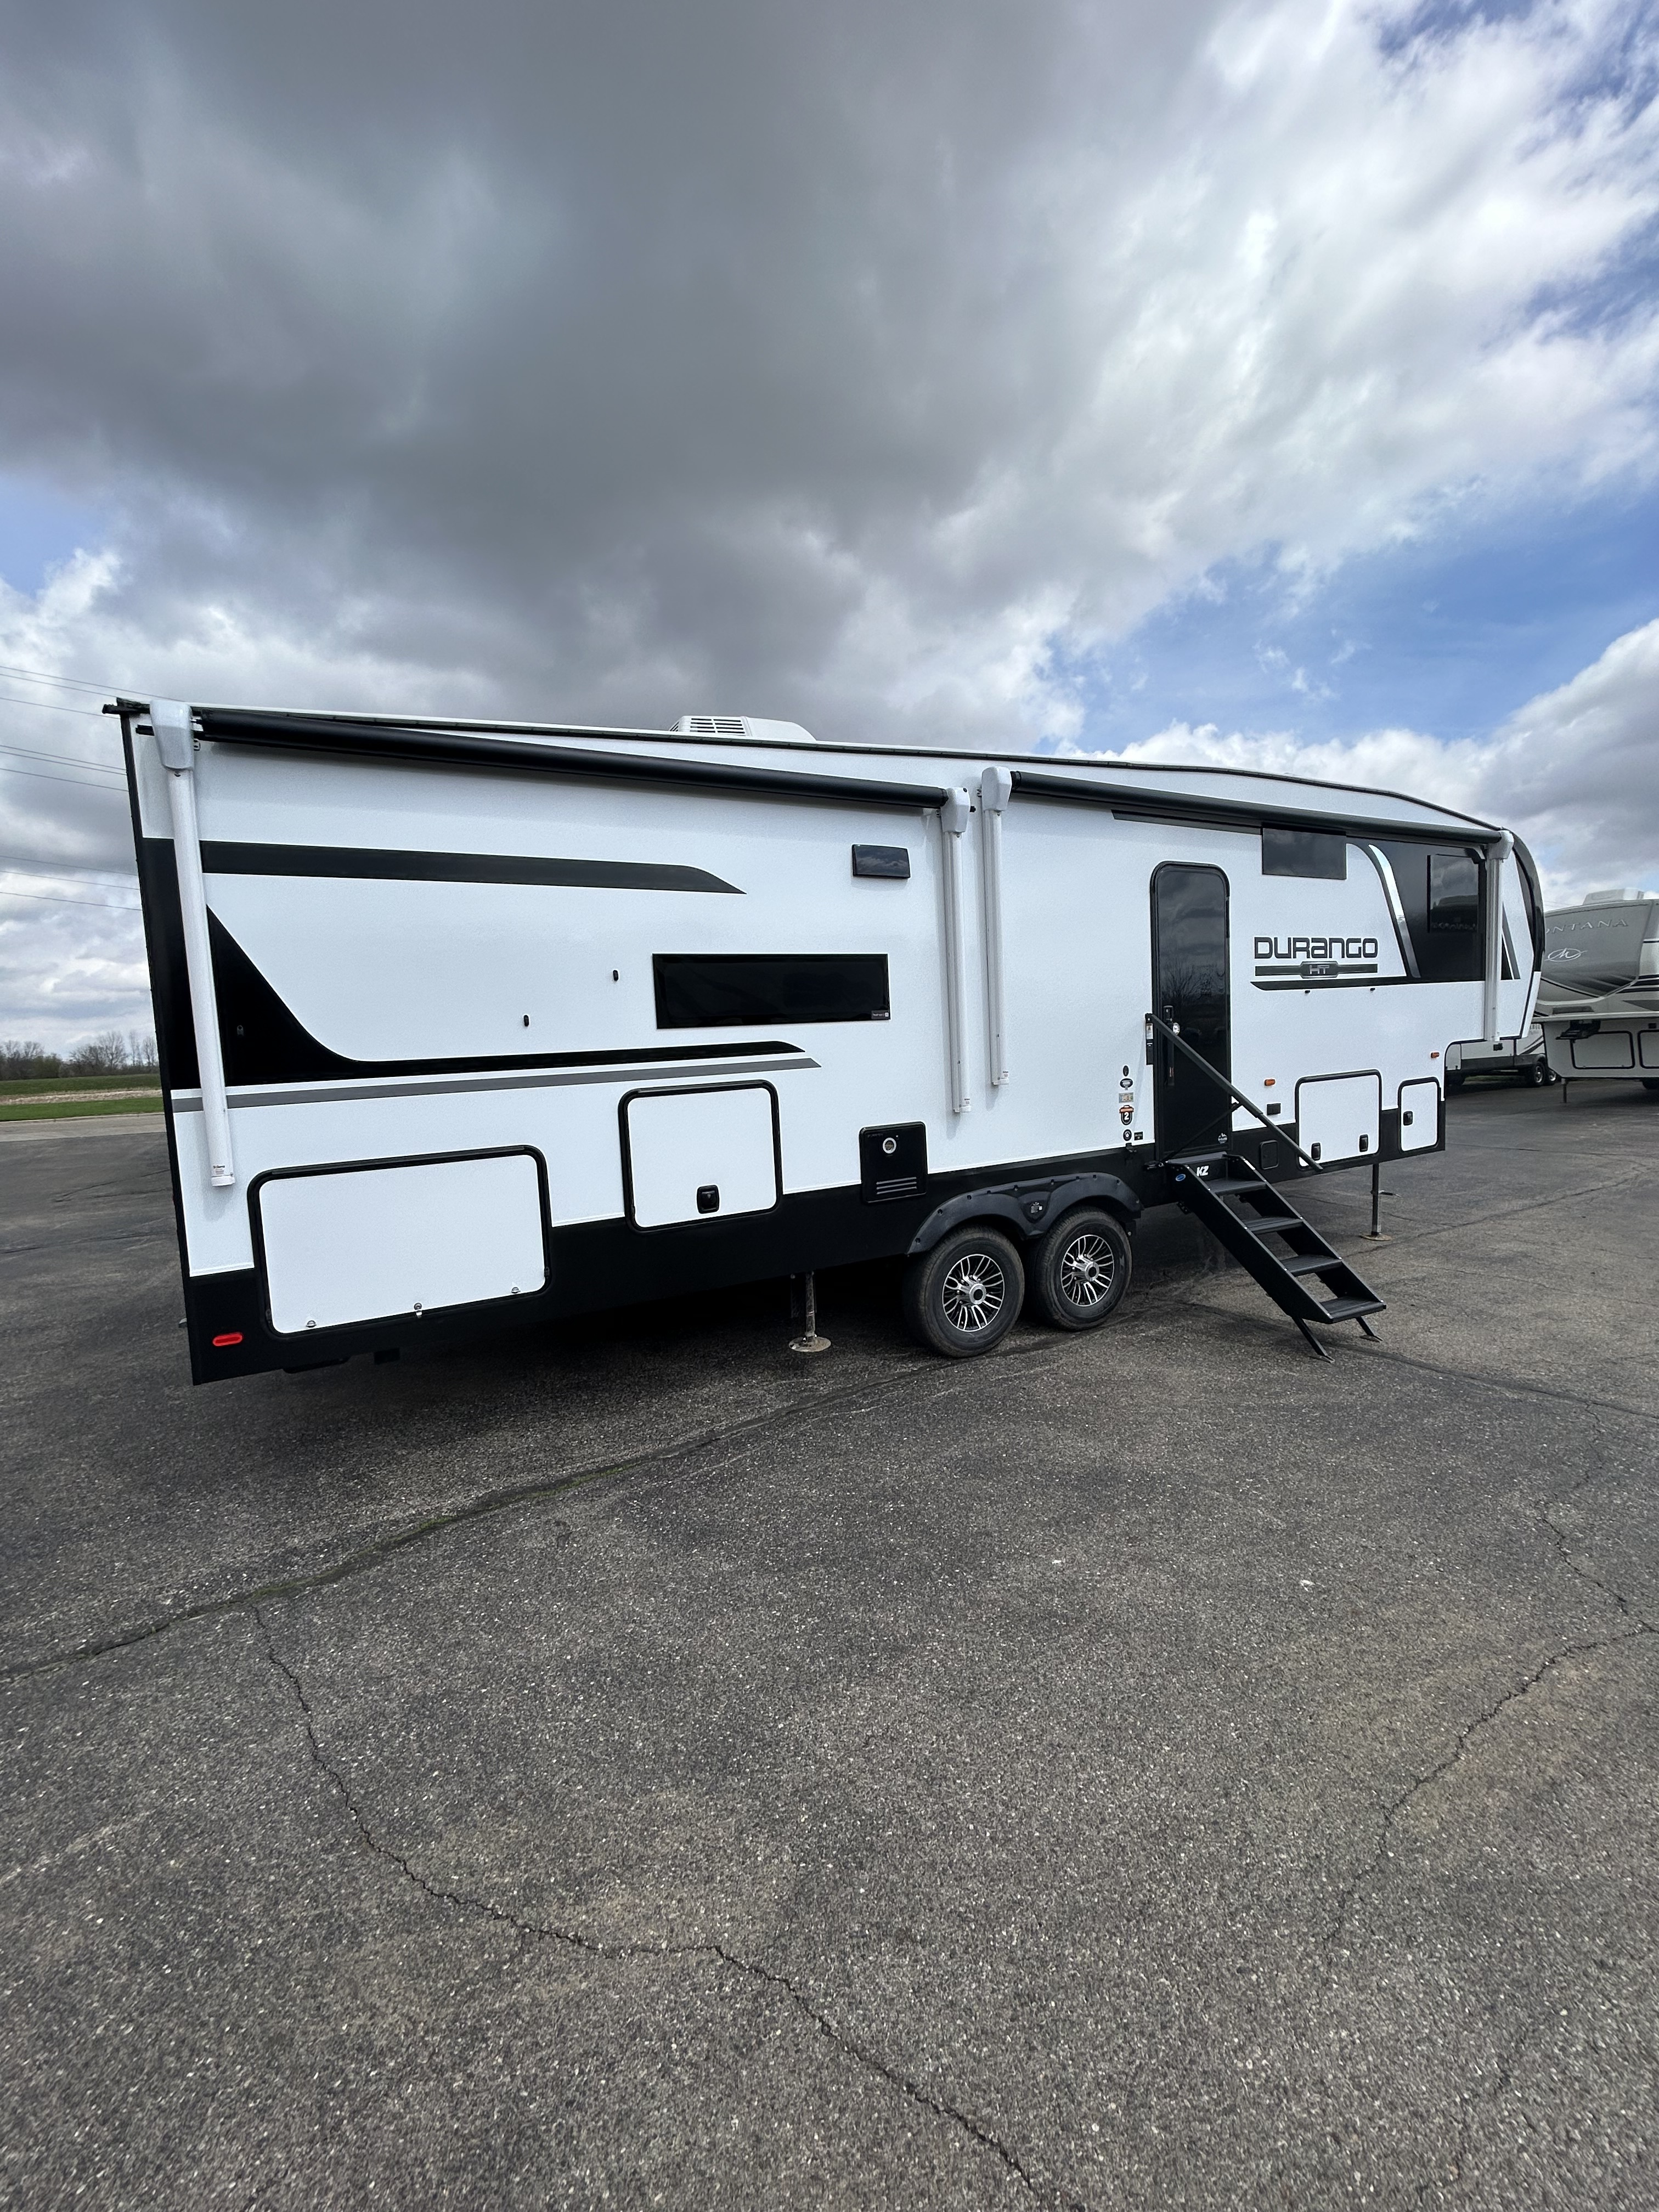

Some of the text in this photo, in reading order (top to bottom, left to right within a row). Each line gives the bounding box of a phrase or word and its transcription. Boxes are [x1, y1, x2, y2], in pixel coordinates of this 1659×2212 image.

[1309, 965, 1330, 974] HT
[1124, 1111, 1130, 1120] 2
[1197, 1165, 1209, 1177] KZ
